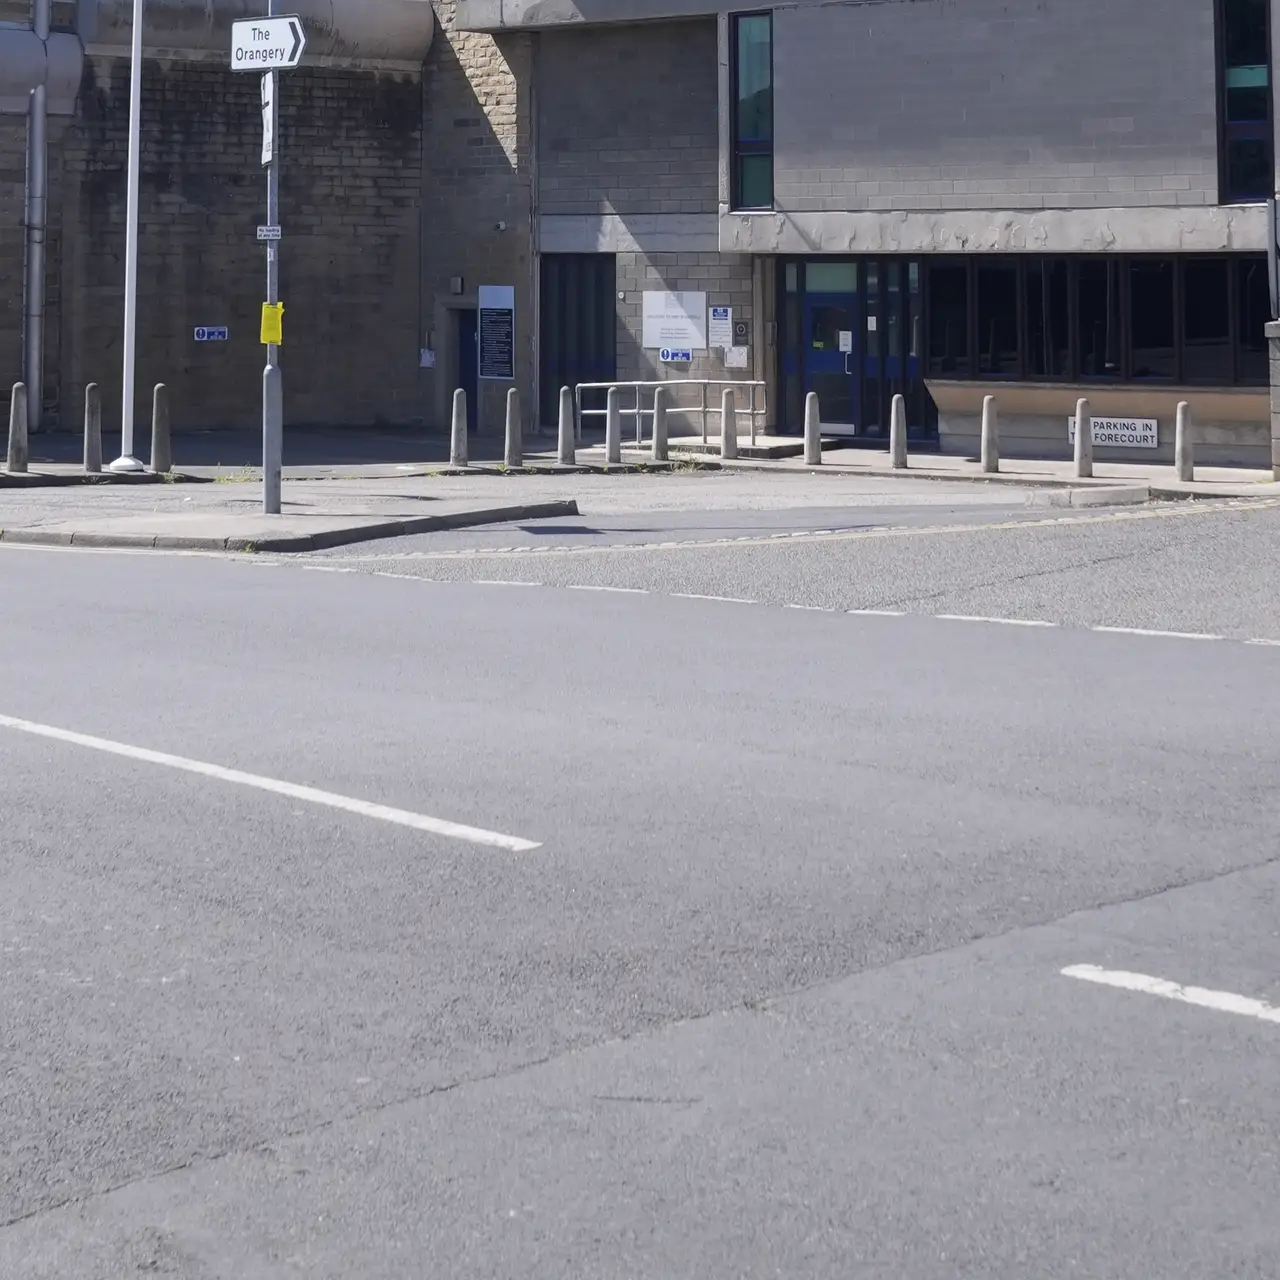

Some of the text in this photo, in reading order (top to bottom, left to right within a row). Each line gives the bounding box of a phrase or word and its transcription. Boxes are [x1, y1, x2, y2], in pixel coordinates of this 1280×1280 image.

[251, 27, 270, 42] The
[235, 47, 286, 62] Orangery
[1093, 421, 1153, 432] PARKING IN
[1094, 433, 1156, 444] FORECOURT
